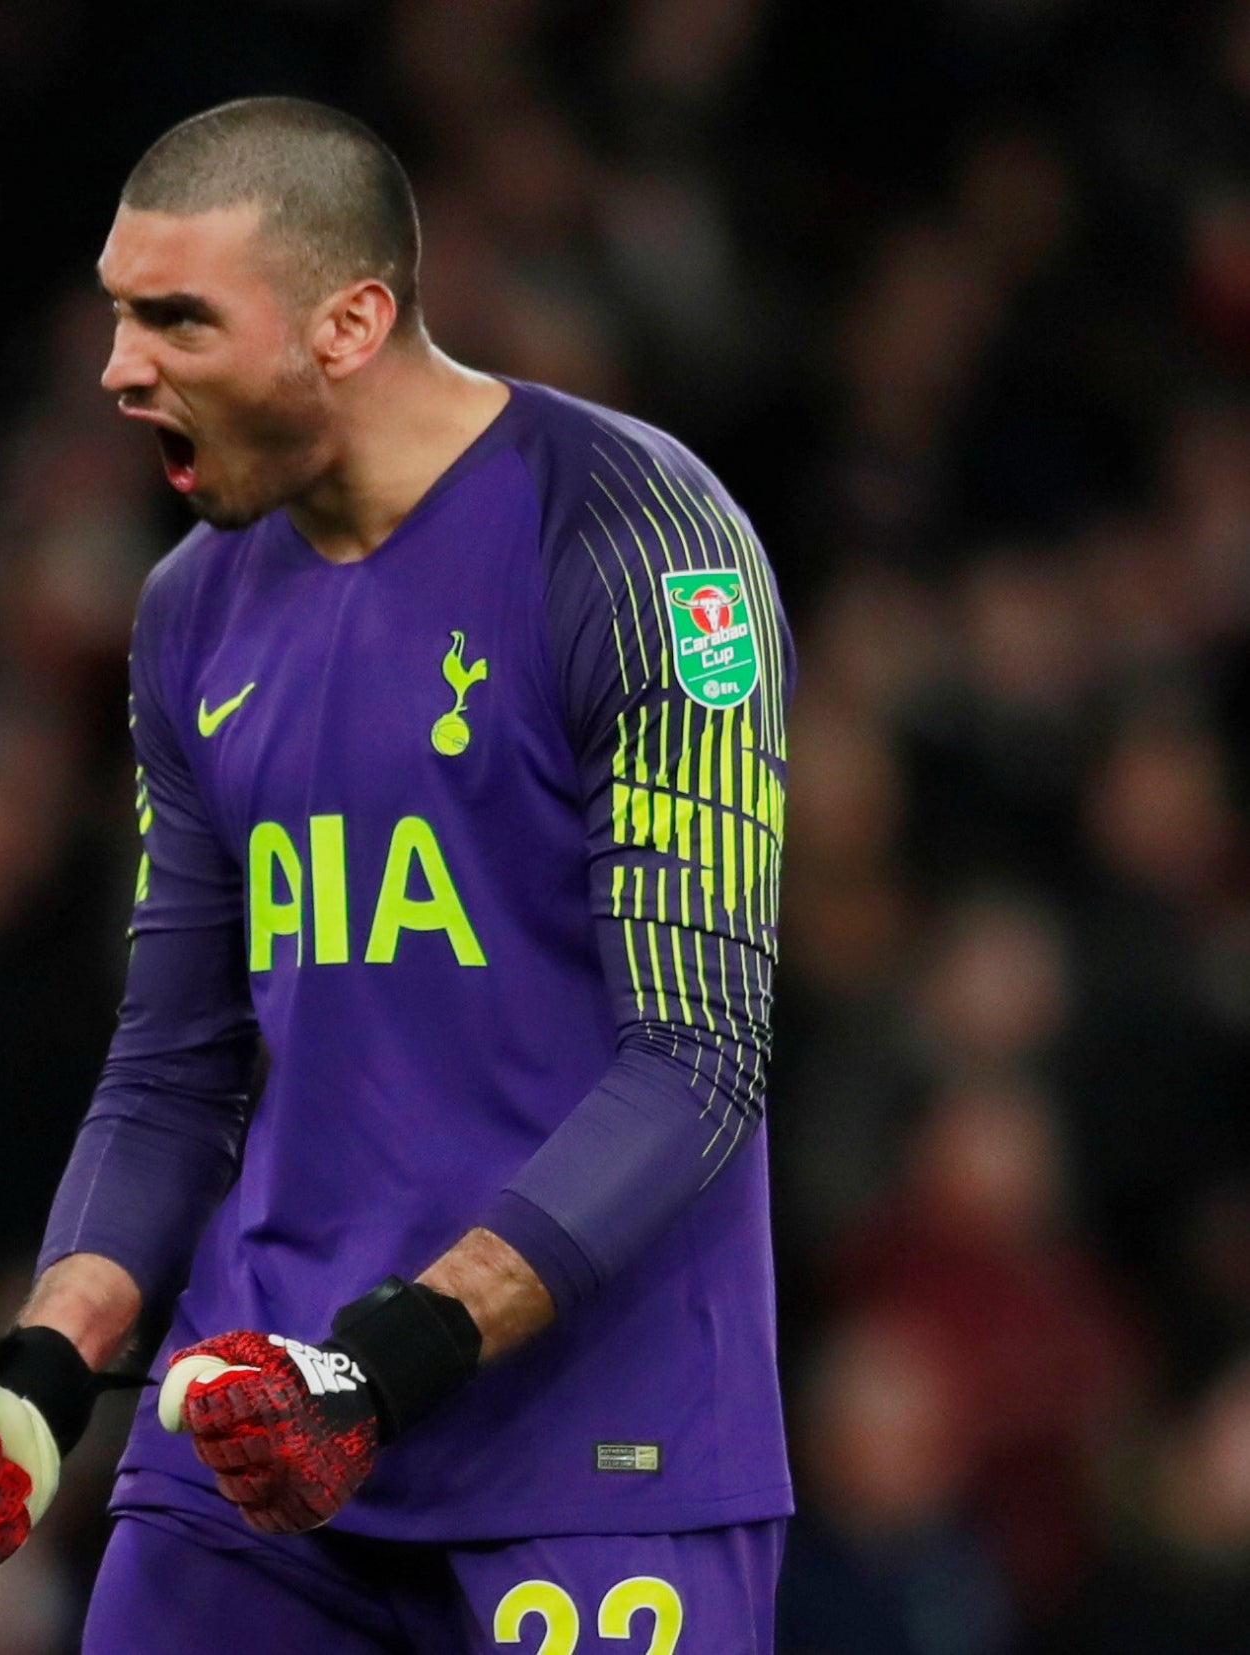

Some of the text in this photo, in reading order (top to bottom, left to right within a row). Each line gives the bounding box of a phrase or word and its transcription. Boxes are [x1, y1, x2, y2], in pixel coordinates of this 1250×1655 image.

[680, 622, 749, 656] Carabao
[701, 646, 735, 668] Cup
[721, 681, 740, 695] EFL
[249, 813, 488, 972] AIA
